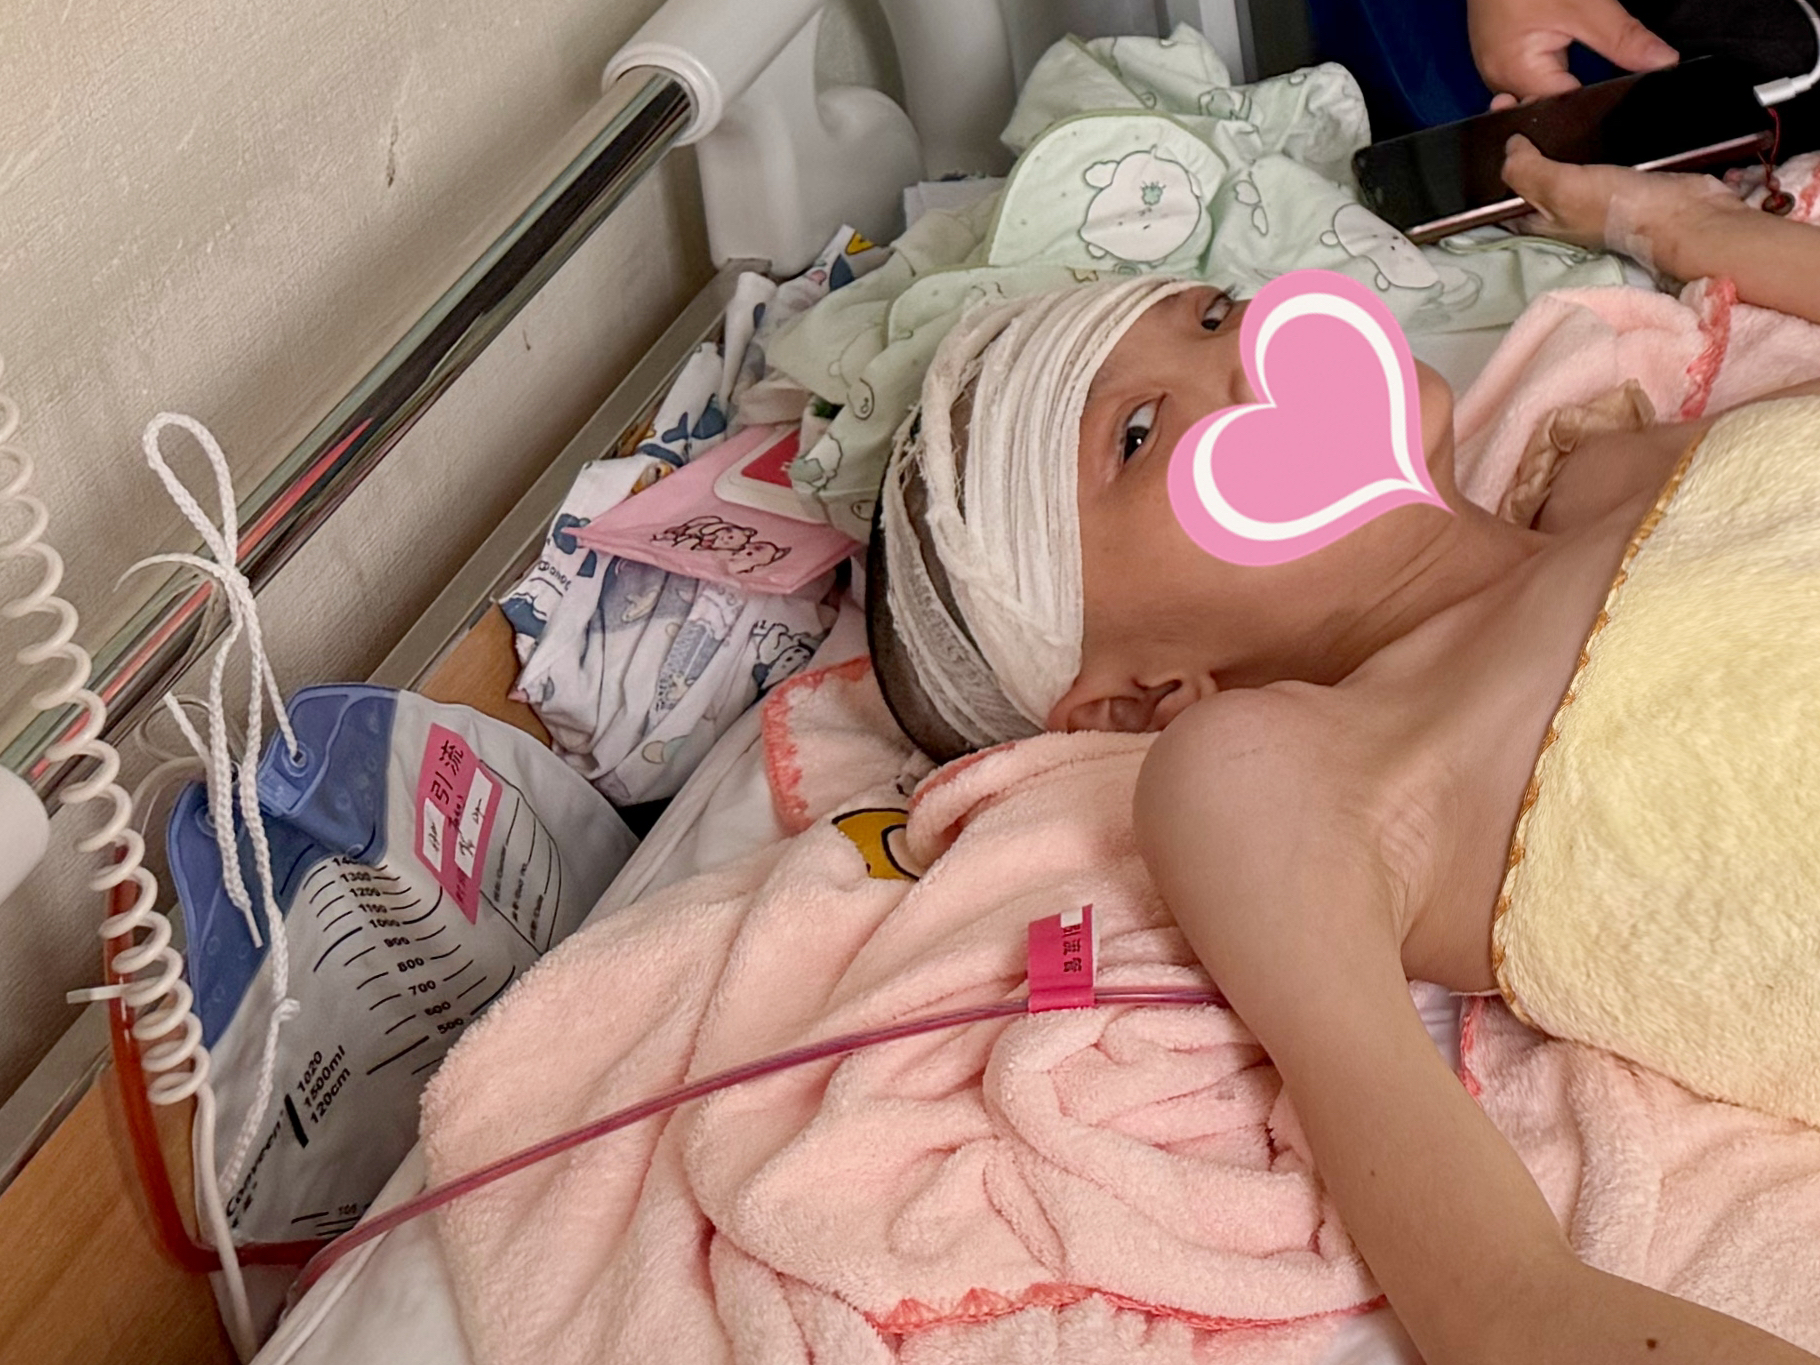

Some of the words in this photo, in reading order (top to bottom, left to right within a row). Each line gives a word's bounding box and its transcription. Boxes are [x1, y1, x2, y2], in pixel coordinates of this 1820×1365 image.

[408, 980, 436, 996] 700
[437, 1017, 464, 1034] 500
[297, 1051, 323, 1093] 1020
[303, 1044, 346, 1108] 1500ml
[309, 1067, 352, 1124] 120cm
